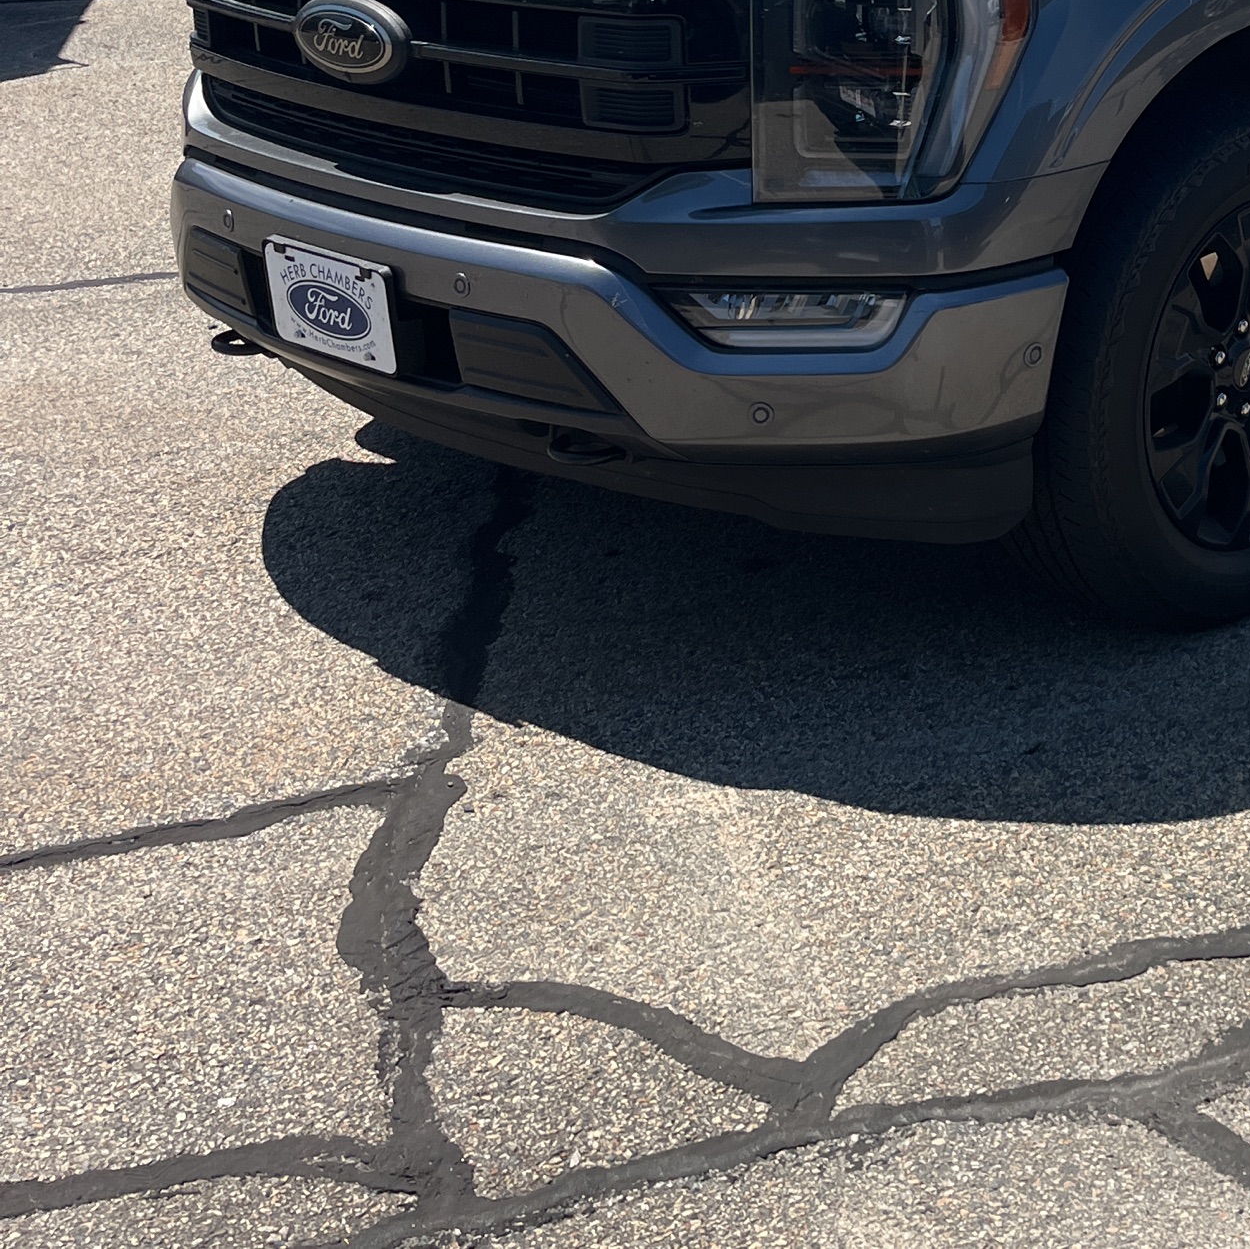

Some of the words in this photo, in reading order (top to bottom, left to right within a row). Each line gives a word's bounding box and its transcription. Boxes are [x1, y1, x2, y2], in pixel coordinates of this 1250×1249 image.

[313, 18, 365, 59] Ford
[280, 263, 306, 285] HERB
[309, 263, 374, 310] CHAMBERS
[305, 288, 352, 330] Ford
